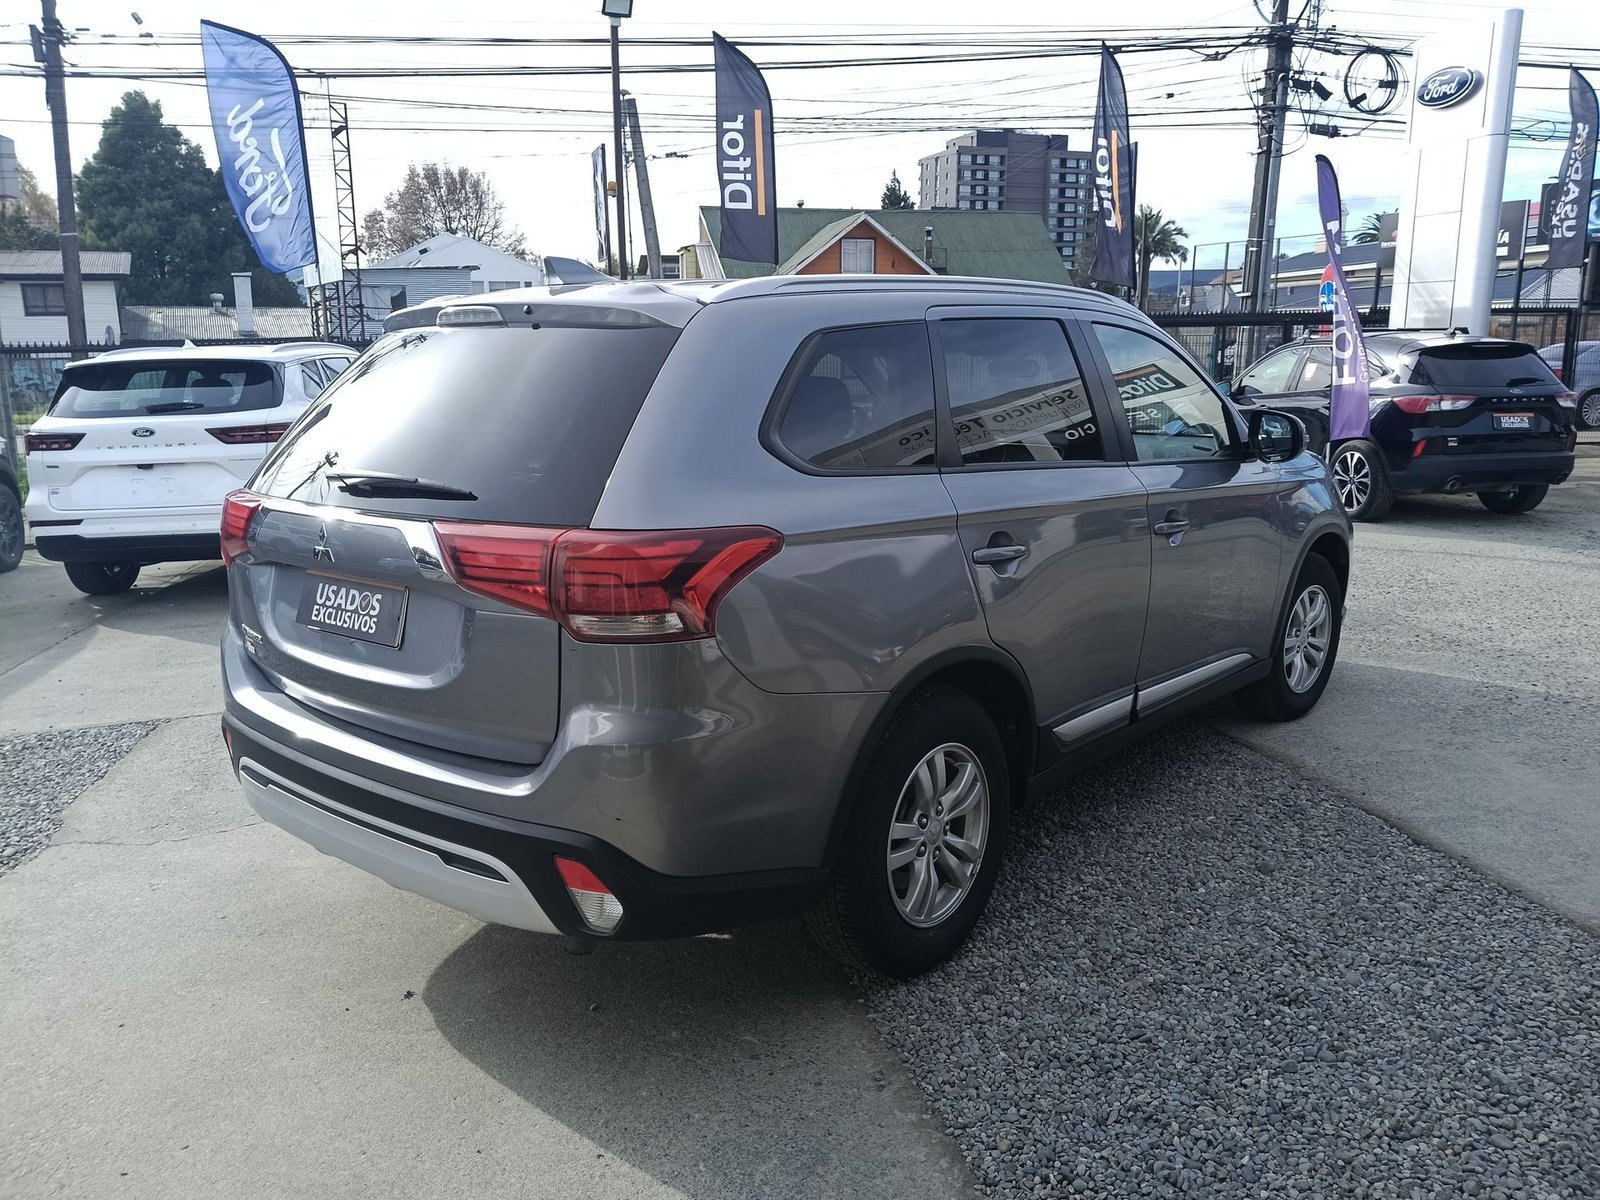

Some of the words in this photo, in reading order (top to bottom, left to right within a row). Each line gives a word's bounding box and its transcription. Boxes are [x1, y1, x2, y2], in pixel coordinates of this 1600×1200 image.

[1423, 74, 1460, 101] Ford
[316, 582, 382, 615] USADOS
[311, 605, 378, 633] EXCLUSIVOS
